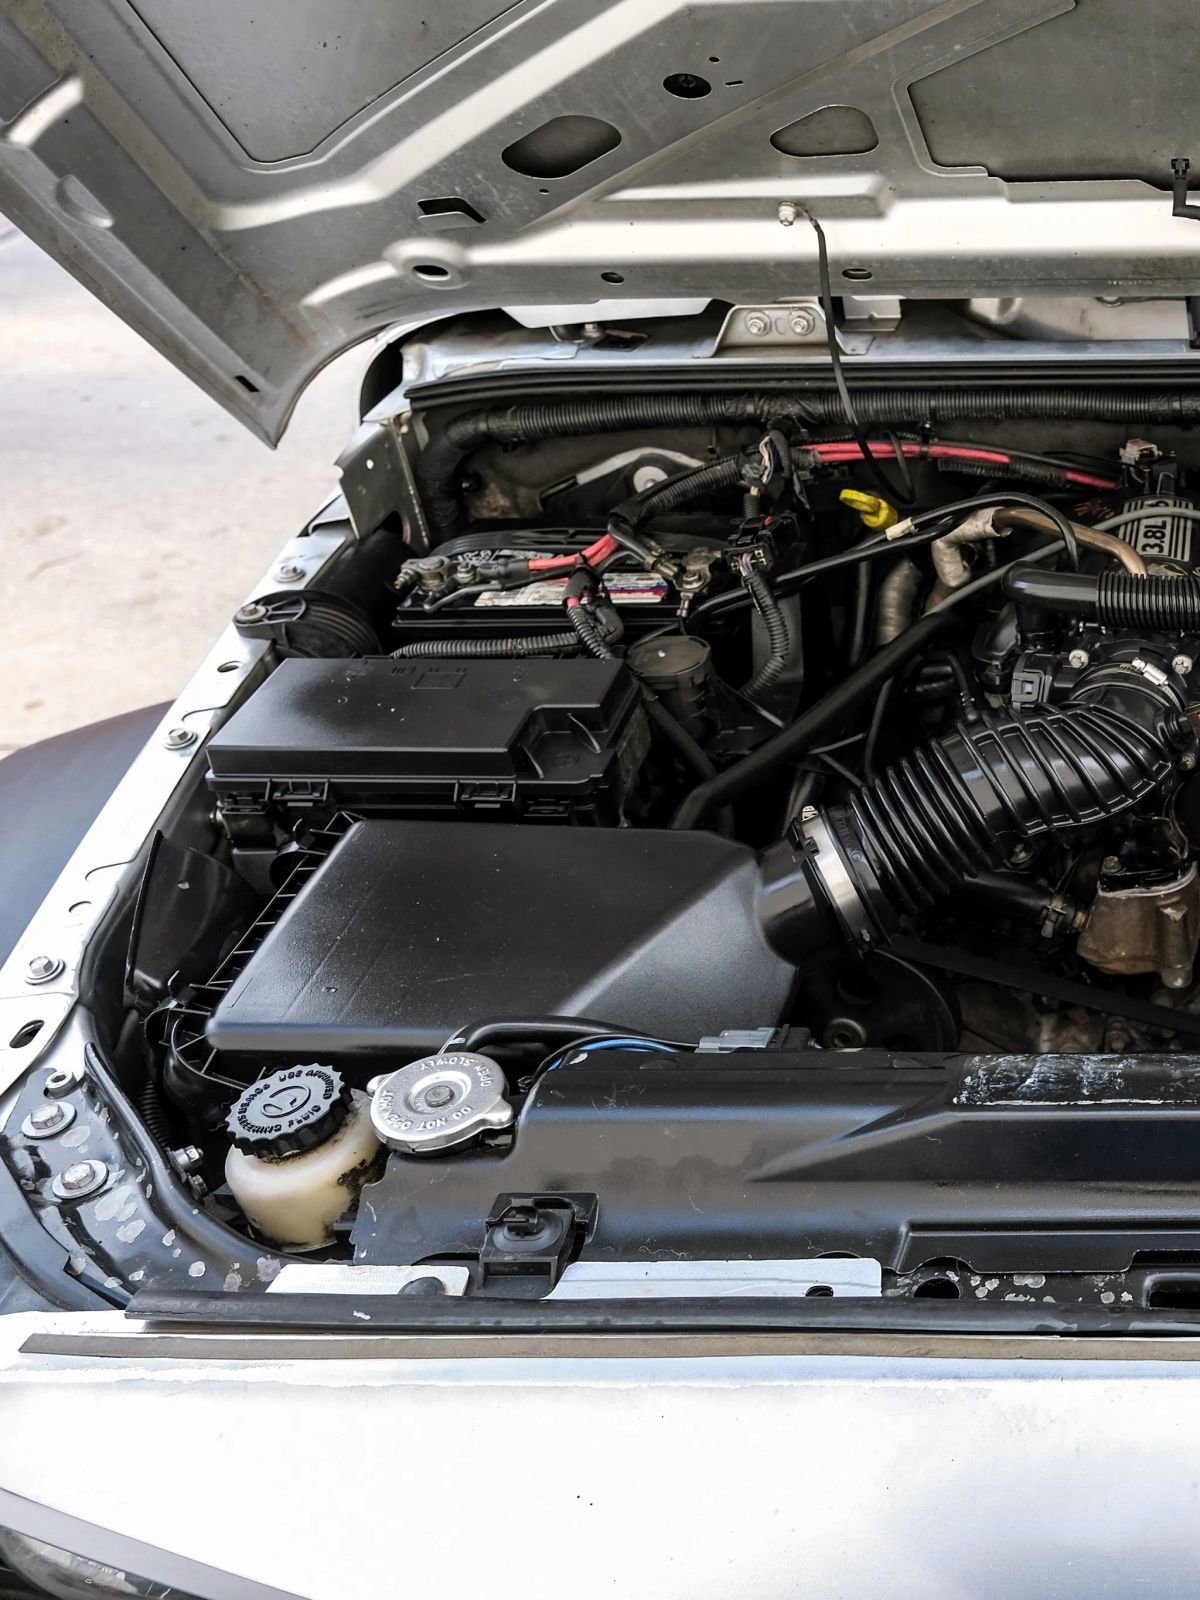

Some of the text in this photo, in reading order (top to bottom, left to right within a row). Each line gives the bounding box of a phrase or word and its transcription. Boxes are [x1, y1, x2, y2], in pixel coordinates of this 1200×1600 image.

[1141, 519, 1167, 554] 3.8L
[420, 1057, 493, 1087] OPEN SLOWLY
[305, 1069, 335, 1100] APPROVED
[379, 1090, 395, 1110] HOT
[382, 1111, 413, 1130] OPEN
[452, 1105, 474, 1120] DO
[416, 1117, 448, 1131] NOT
